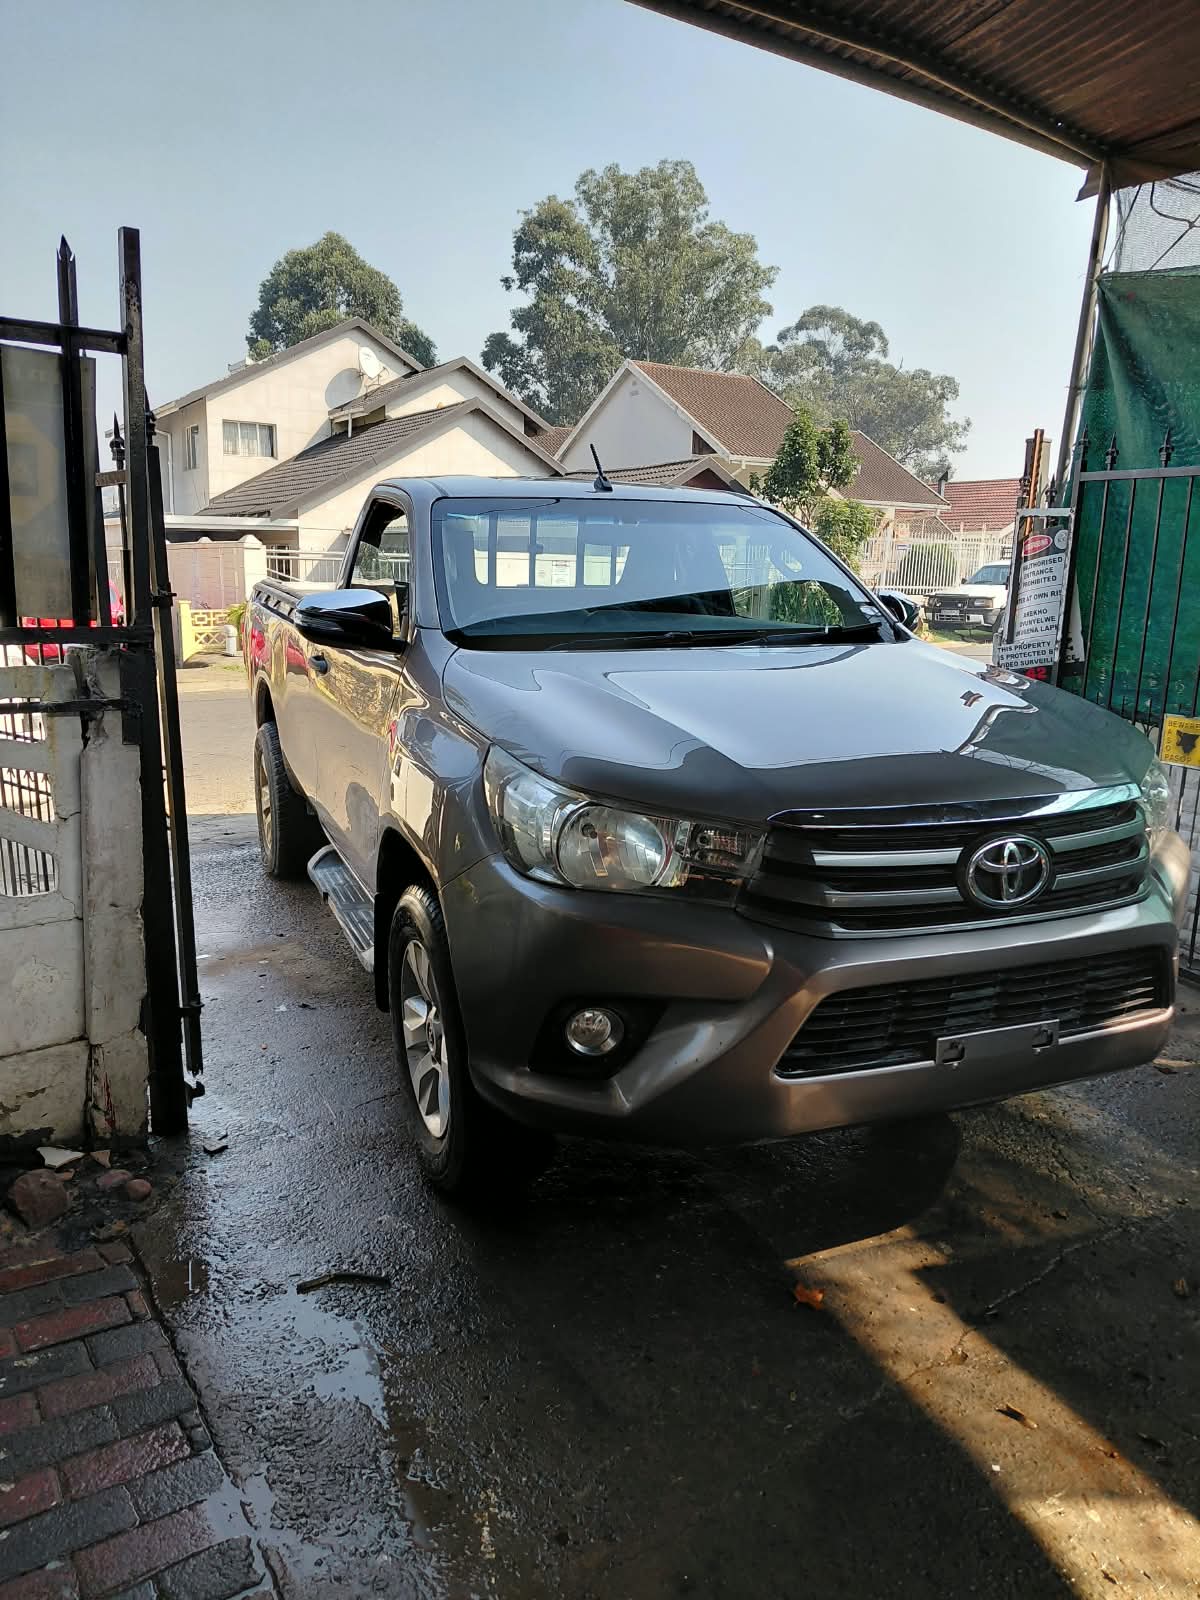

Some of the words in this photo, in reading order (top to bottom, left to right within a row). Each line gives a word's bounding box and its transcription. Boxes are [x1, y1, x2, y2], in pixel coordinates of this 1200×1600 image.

[1033, 591, 1049, 600] OWN
[1014, 641, 1051, 651] PROPERTY
[1006, 649, 1046, 660] PROTECTED
